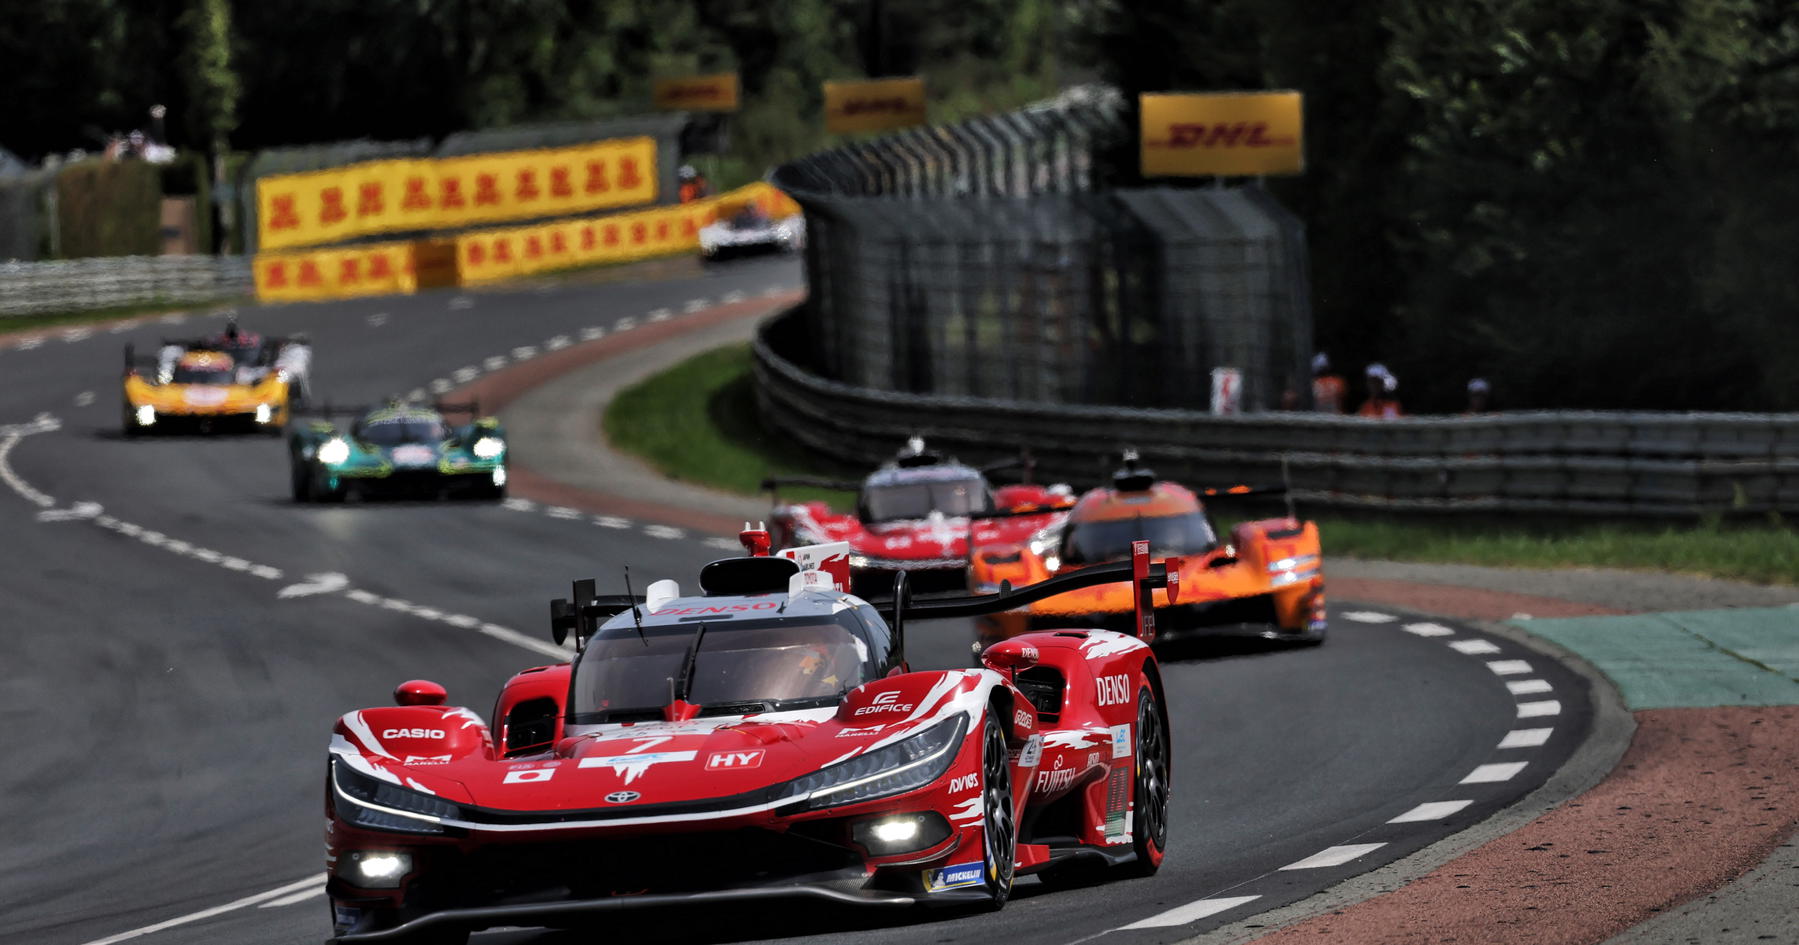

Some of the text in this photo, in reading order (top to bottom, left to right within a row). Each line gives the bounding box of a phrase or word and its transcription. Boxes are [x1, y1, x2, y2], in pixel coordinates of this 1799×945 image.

[1168, 121, 1273, 149] DHL
[649, 602, 777, 616] DENSO
[1096, 673, 1130, 706] DENSO
[854, 703, 913, 716] EDIFICE
[382, 728, 446, 740] CASIO
[625, 736, 674, 754] 7
[710, 752, 759, 767] HY
[1034, 767, 1077, 799] FUJITSU
[946, 869, 982, 883] MICHELIN
